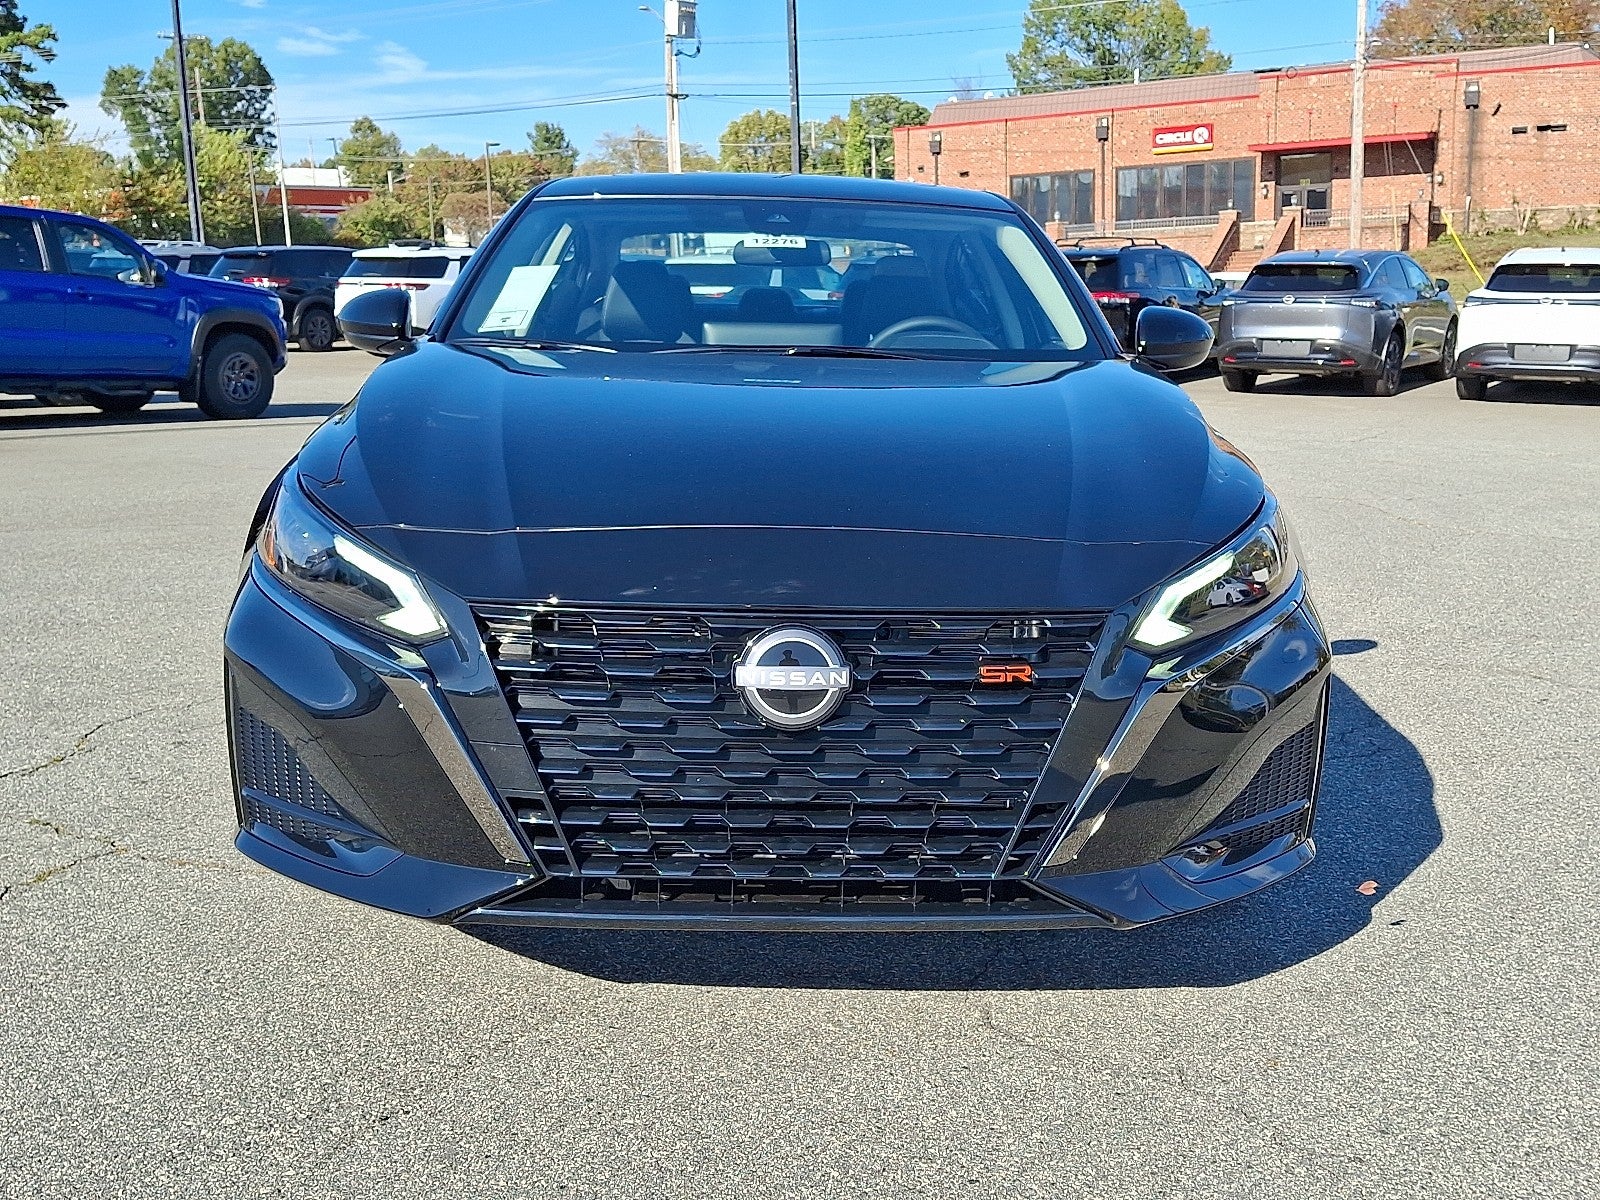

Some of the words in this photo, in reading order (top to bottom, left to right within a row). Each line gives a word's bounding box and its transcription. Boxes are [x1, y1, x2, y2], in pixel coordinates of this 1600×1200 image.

[1155, 131, 1193, 145] CIRCLE
[738, 670, 848, 687] NISSAN
[979, 664, 1032, 683] SR
